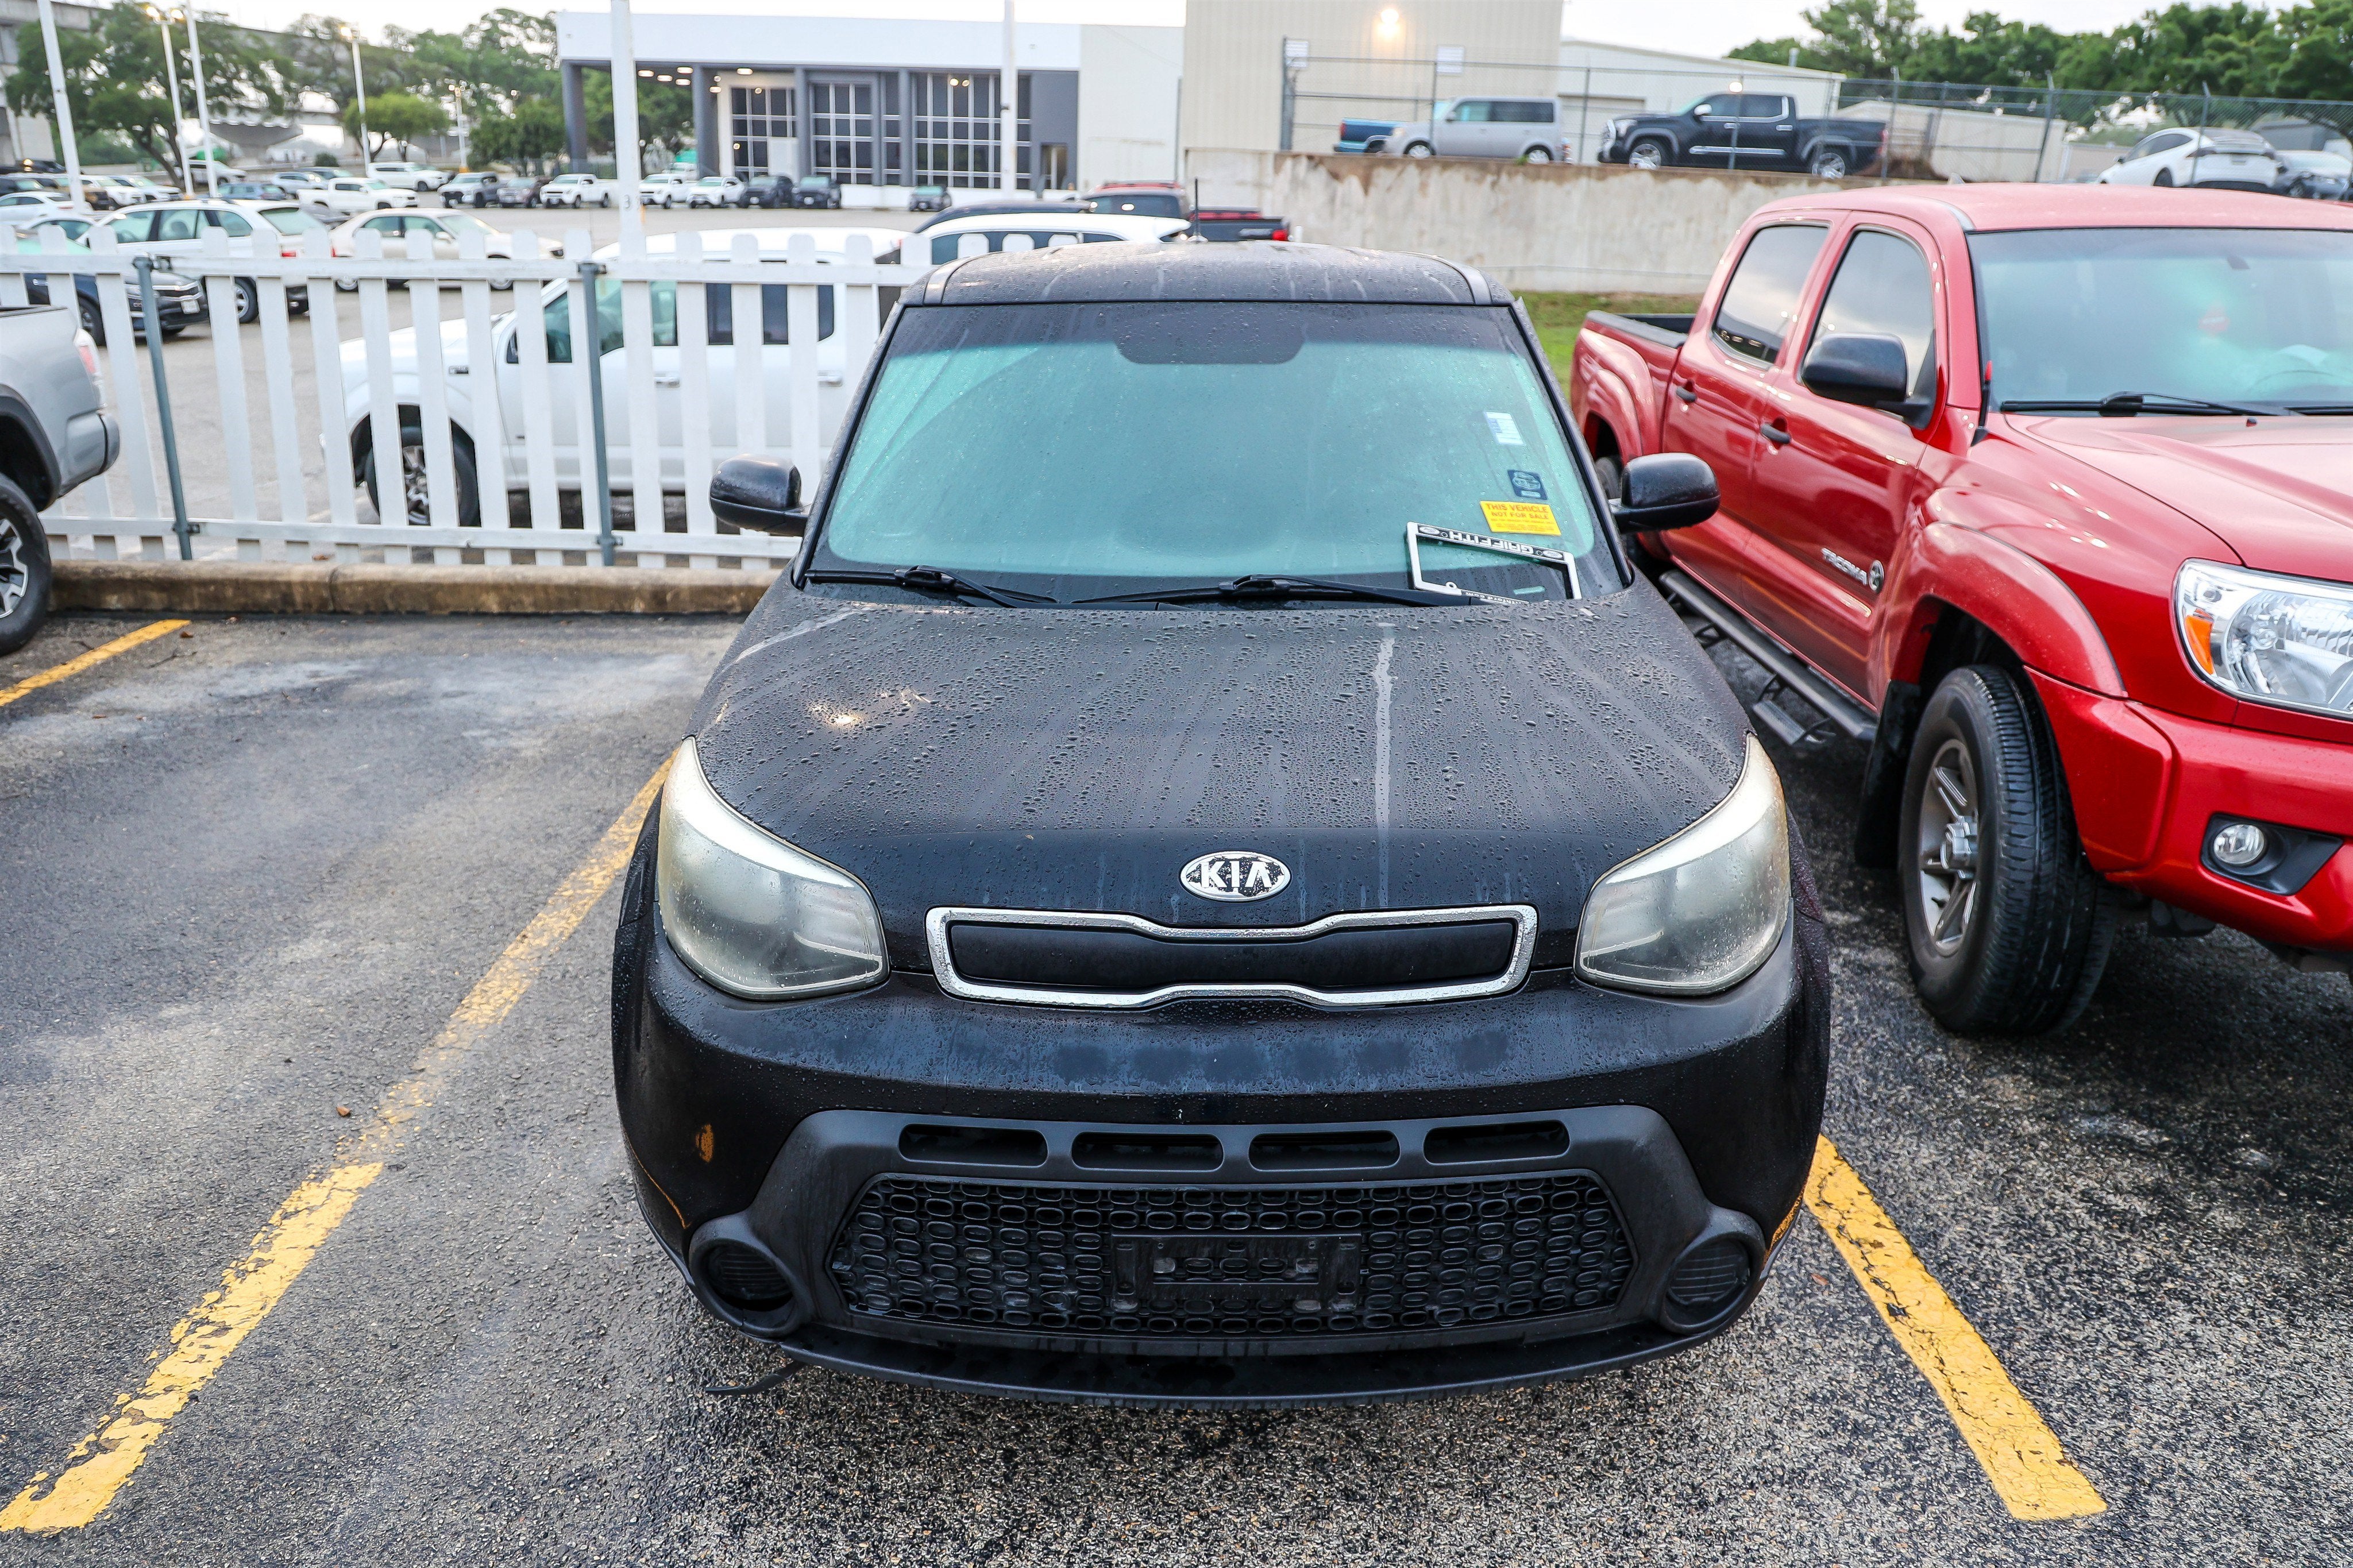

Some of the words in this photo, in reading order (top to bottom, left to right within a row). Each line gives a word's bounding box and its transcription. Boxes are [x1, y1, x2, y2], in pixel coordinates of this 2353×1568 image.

[1509, 504, 1548, 513] VEHICLE
[1449, 531, 1534, 554] GRIFFITH
[1199, 860, 1273, 888] KIA
